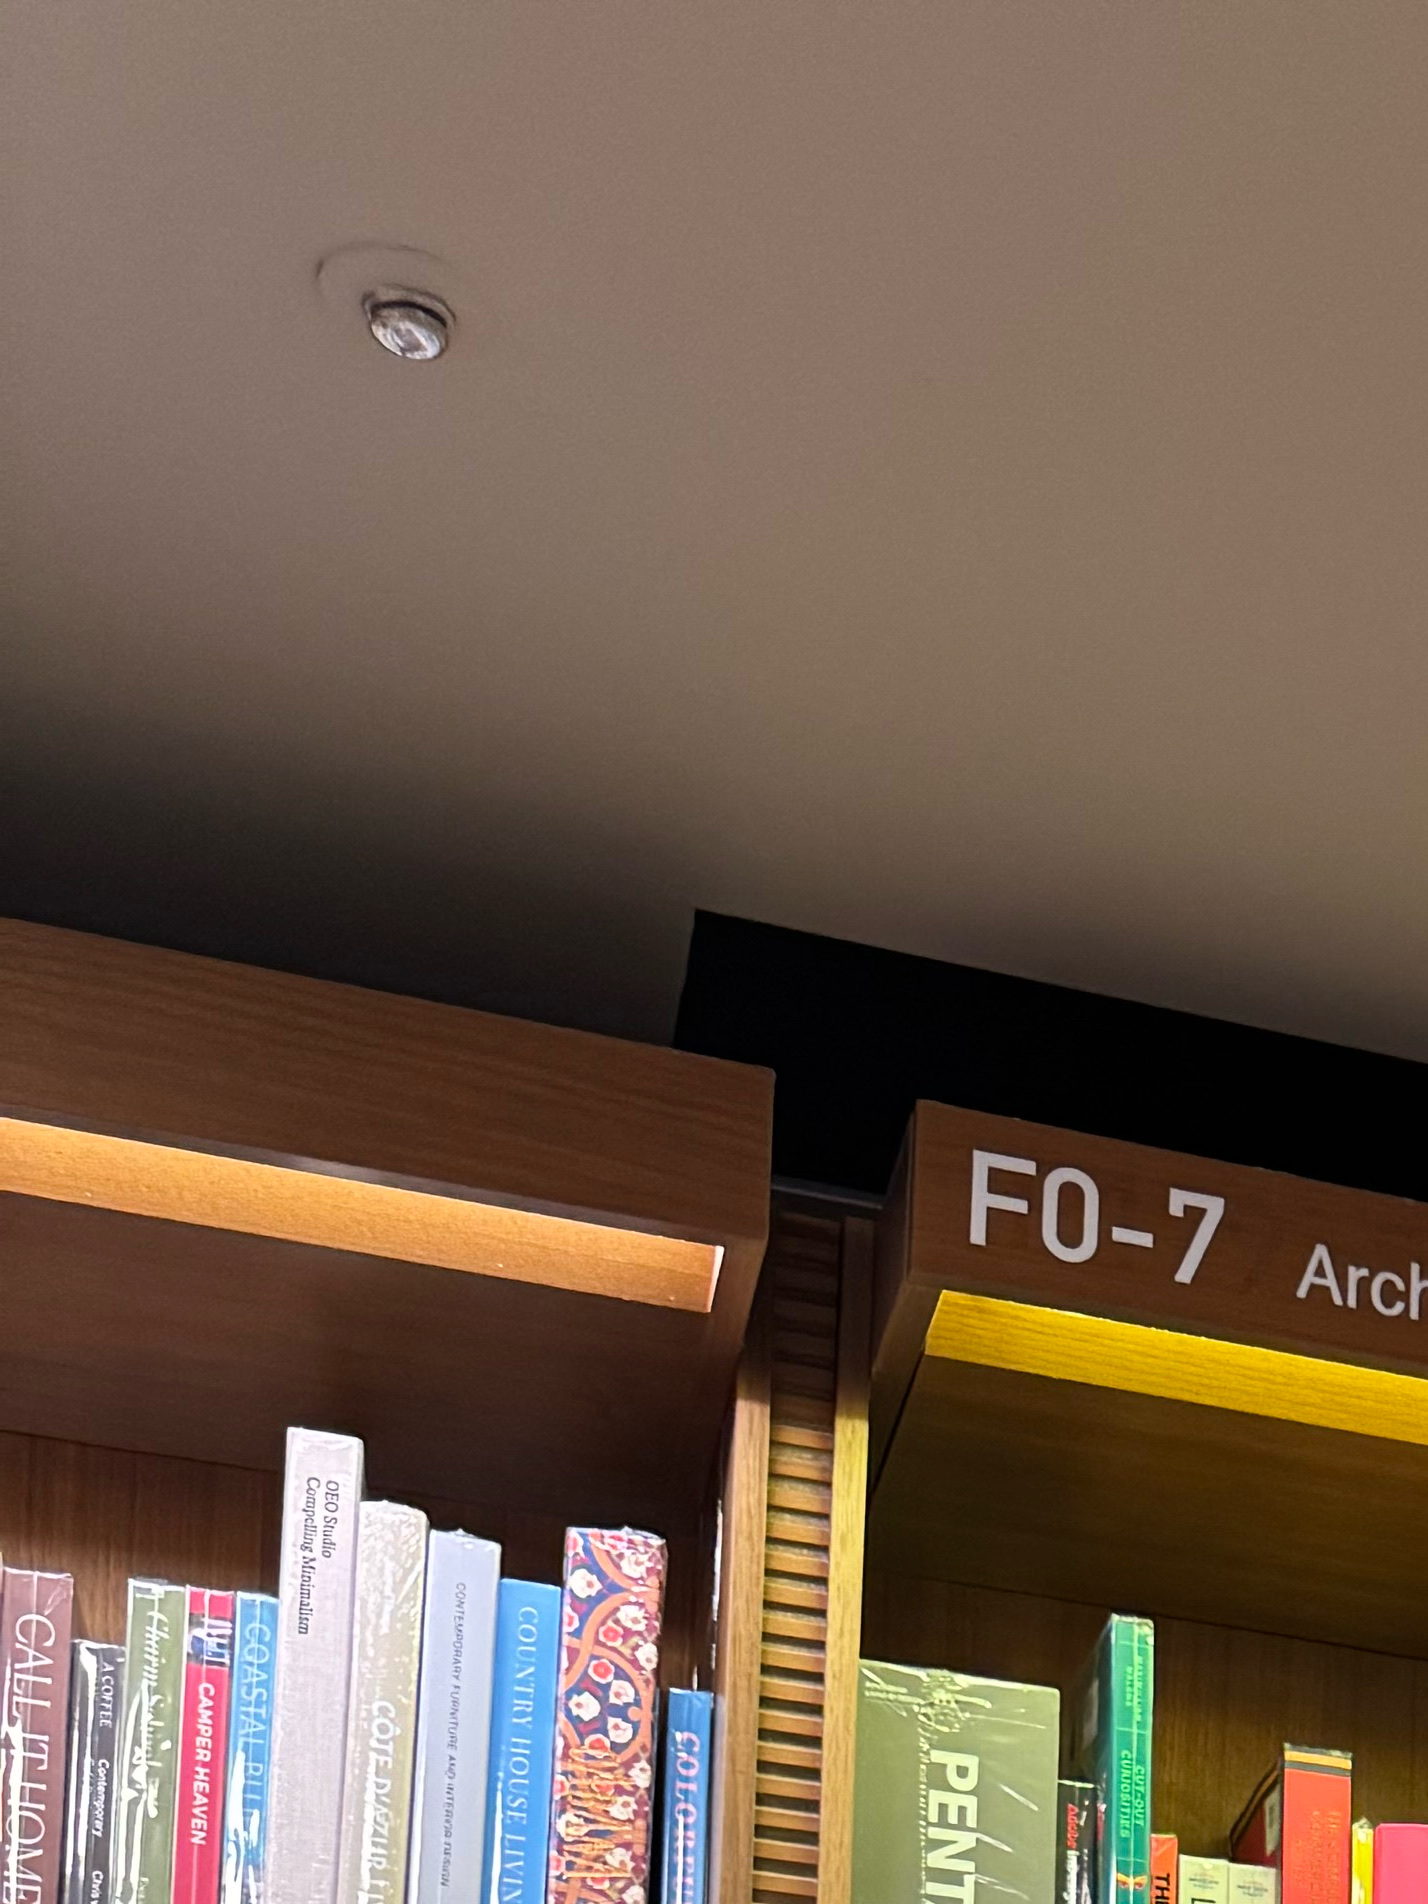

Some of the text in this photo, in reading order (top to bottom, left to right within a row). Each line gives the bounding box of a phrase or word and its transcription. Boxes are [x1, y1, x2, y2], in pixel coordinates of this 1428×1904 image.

[969, 1149, 1225, 1283] F0-7
[296, 1476, 321, 1635] Compelling Minimalism
[320, 1480, 341, 1560] OEO Studio
[515, 1606, 539, 1726] COUNTRY
[188, 1682, 216, 1846] CAMPER HEAVEN
[508, 1732, 533, 1826] HOUSE
